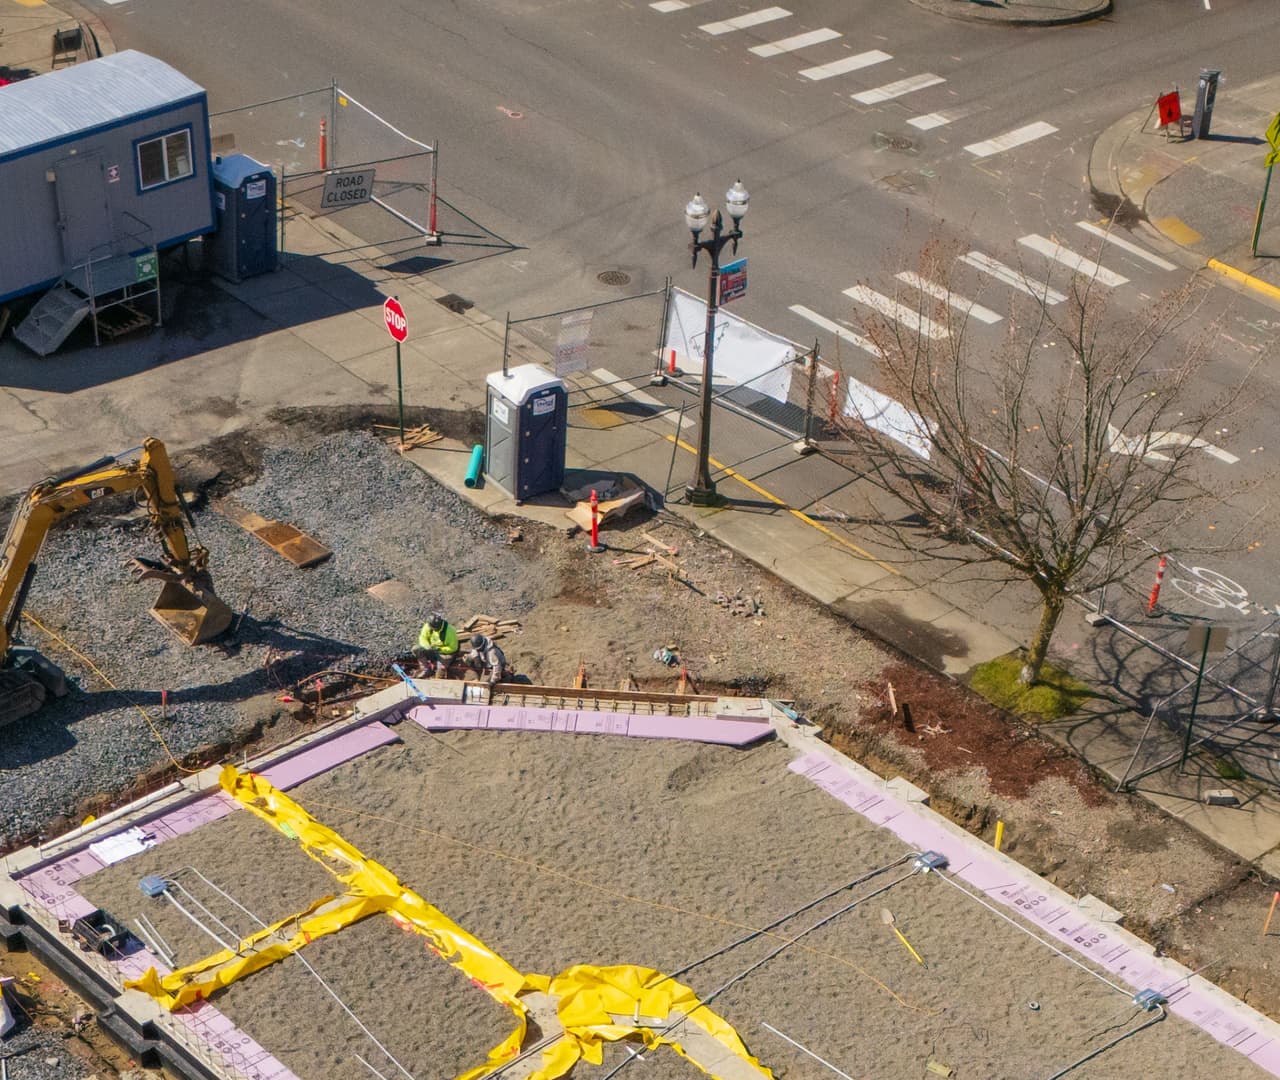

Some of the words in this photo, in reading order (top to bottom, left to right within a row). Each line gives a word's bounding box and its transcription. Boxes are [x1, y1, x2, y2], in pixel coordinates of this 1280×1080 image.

[335, 175, 364, 189] ROAD
[327, 188, 367, 203] CLOSED
[386, 307, 406, 331] STOP
[91, 487, 105, 499] CAT
